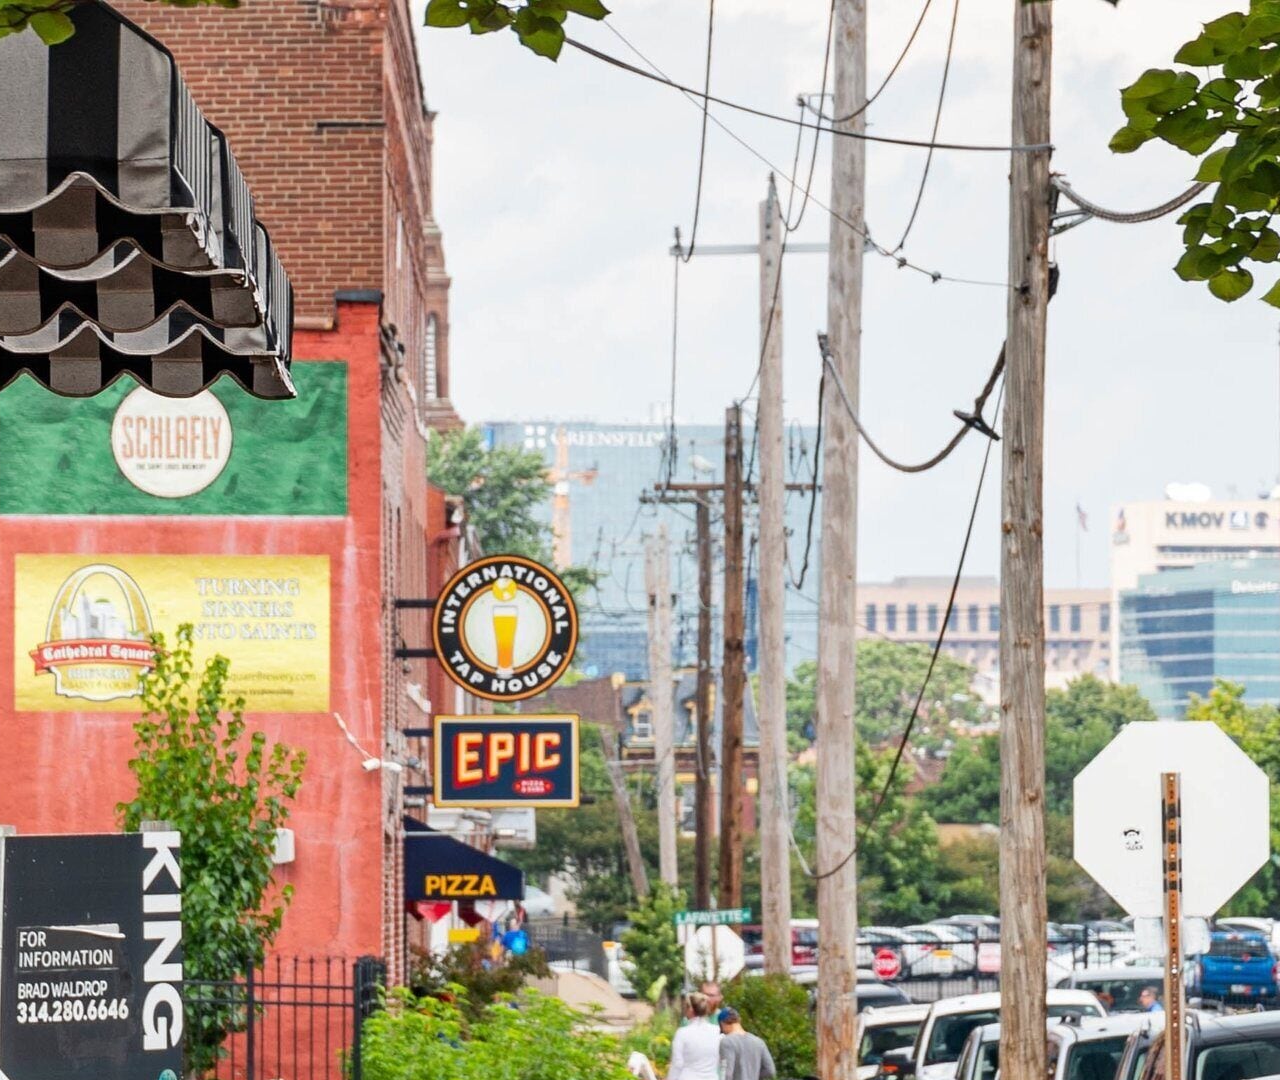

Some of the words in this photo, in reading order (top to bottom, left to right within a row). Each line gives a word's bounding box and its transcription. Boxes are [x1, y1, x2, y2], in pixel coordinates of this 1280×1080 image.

[122, 415, 222, 459] SCHLAFLY
[1165, 511, 1224, 527] KMOV
[195, 577, 300, 596] TURNING
[202, 600, 294, 617] SINNERS
[441, 565, 569, 635] INTERNATIONAL
[194, 623, 237, 640] NTO
[240, 623, 317, 640] SAINTS
[43, 644, 108, 661] Cathedral
[450, 650, 485, 684] TAP
[490, 650, 562, 692] HOUSE
[454, 732, 561, 787] EPIC
[425, 874, 497, 896] PIZZA
[19, 931, 47, 948] FOR
[142, 831, 184, 1050] KING
[18, 949, 113, 968] INFORMATION
[18, 983, 50, 999] BRAD
[51, 980, 108, 998] WALDROP
[16, 998, 130, 1024] 314.280.6646
